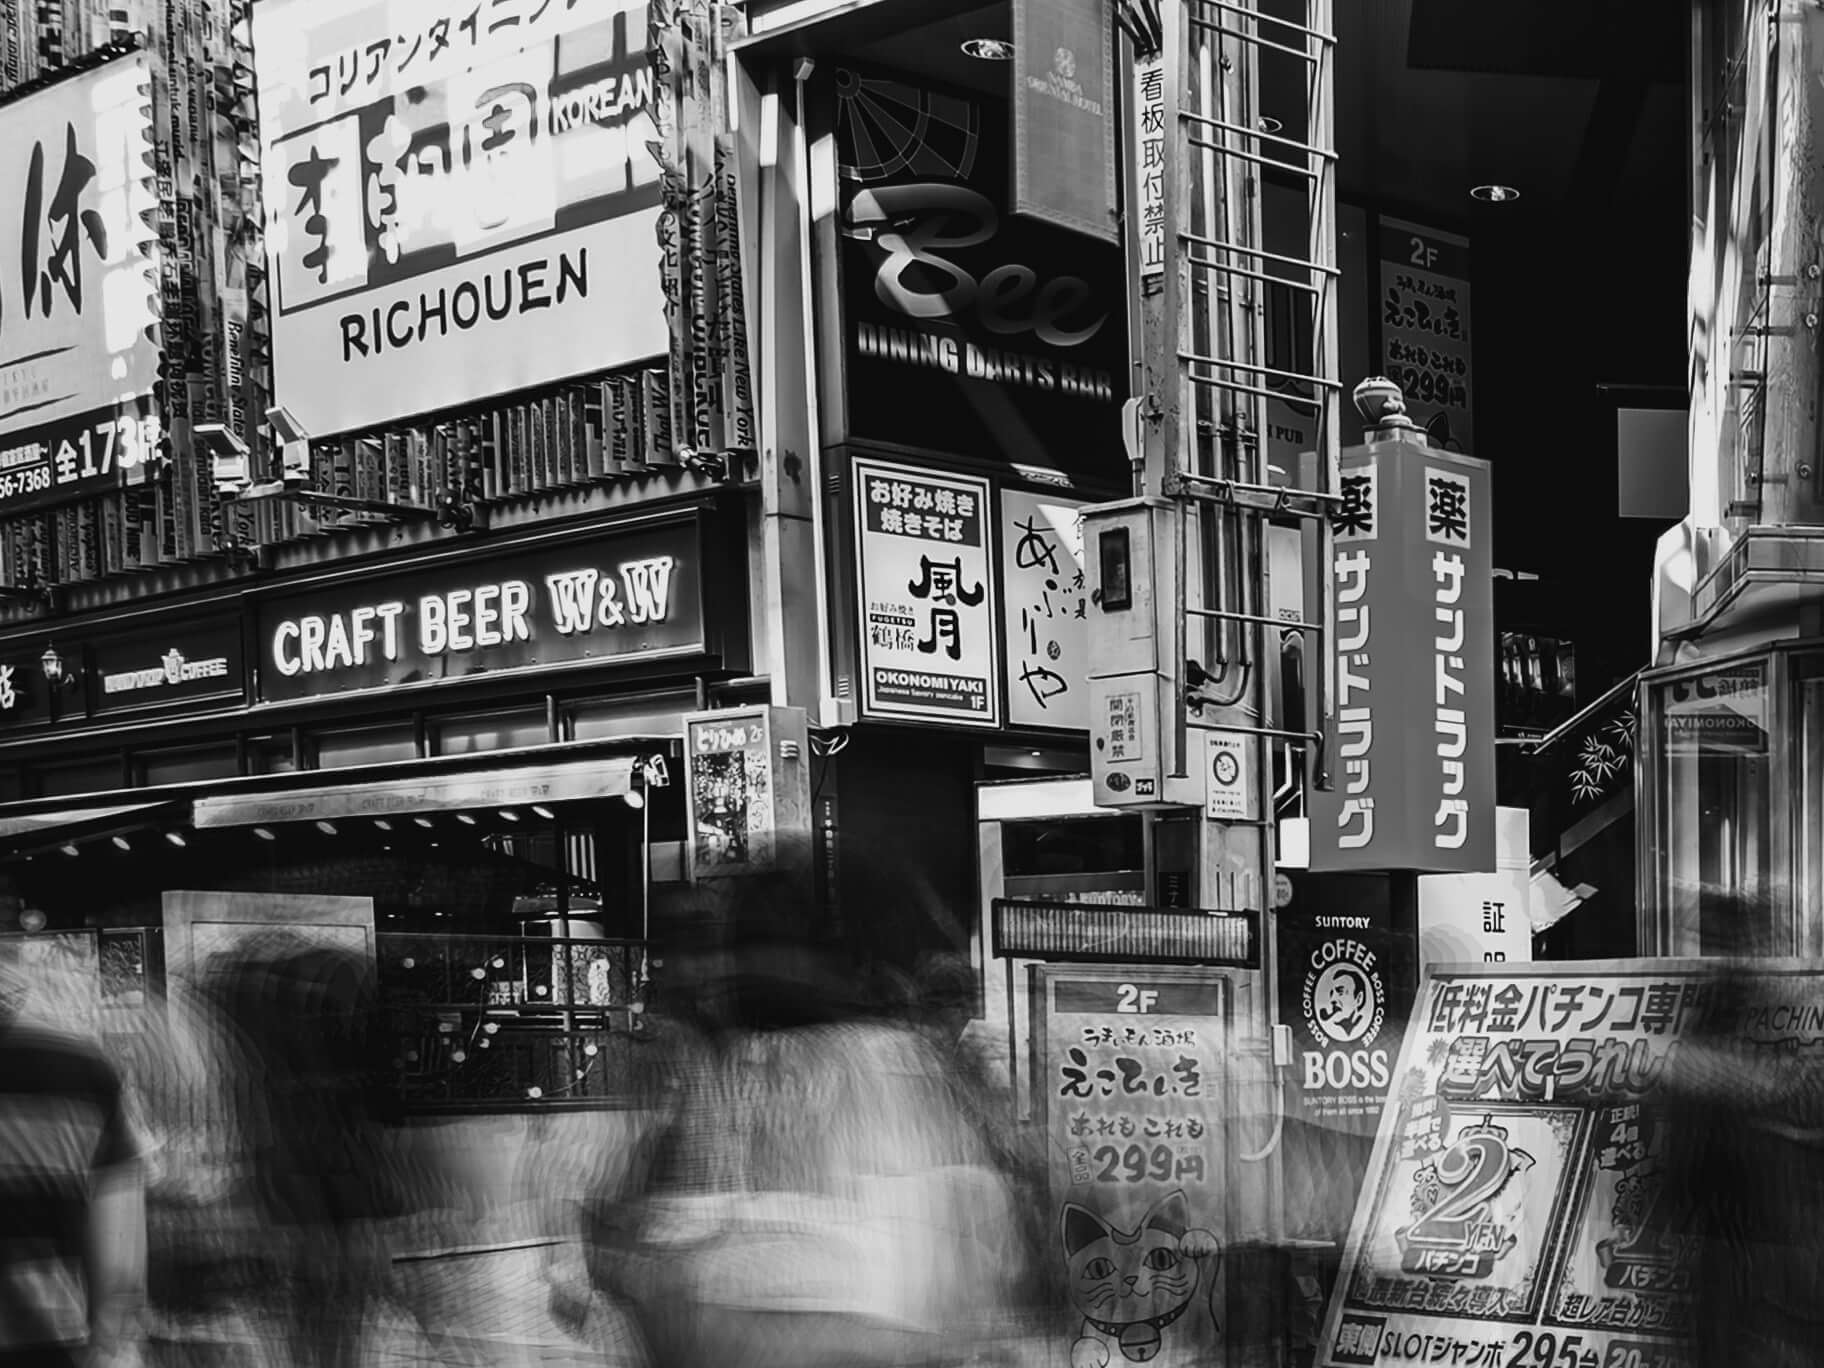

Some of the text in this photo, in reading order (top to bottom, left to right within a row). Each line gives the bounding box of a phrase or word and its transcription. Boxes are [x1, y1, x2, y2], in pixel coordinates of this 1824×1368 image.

[552, 66, 655, 134] KOREAN
[1140, 68, 1165, 267] 看板取付禁止
[846, 183, 1111, 347] Bee
[1409, 236, 1439, 268] 2F
[339, 247, 588, 362] RICHOUEN
[858, 319, 1113, 401] DINING DARTS BAR
[870, 479, 975, 518] お好み焼き
[879, 507, 964, 541] 焼きそば
[1334, 475, 1375, 537] 薬
[1426, 477, 1470, 543] 薬
[272, 556, 674, 677] CRAFT BEER W&W
[908, 553, 985, 662] 風月
[1012, 514, 1069, 710] あぶりや
[875, 670, 985, 694] OKONOMIYAKI
[970, 694, 985, 710] 1F
[1334, 549, 1375, 849] サンドラッグ
[1431, 550, 1469, 849] サンドラッグ
[1315, 915, 1371, 929] SUNTORY
[1311, 938, 1377, 973] COFFEE
[1116, 983, 1159, 1014] 2F
[1059, 1047, 1202, 1099] えこひいき
[1302, 1049, 1390, 1090] BOSS
[1070, 1110, 1205, 1140] あれも これも
[1093, 1142, 1206, 1183] 299円
[1413, 1249, 1480, 1276] パチンコ
